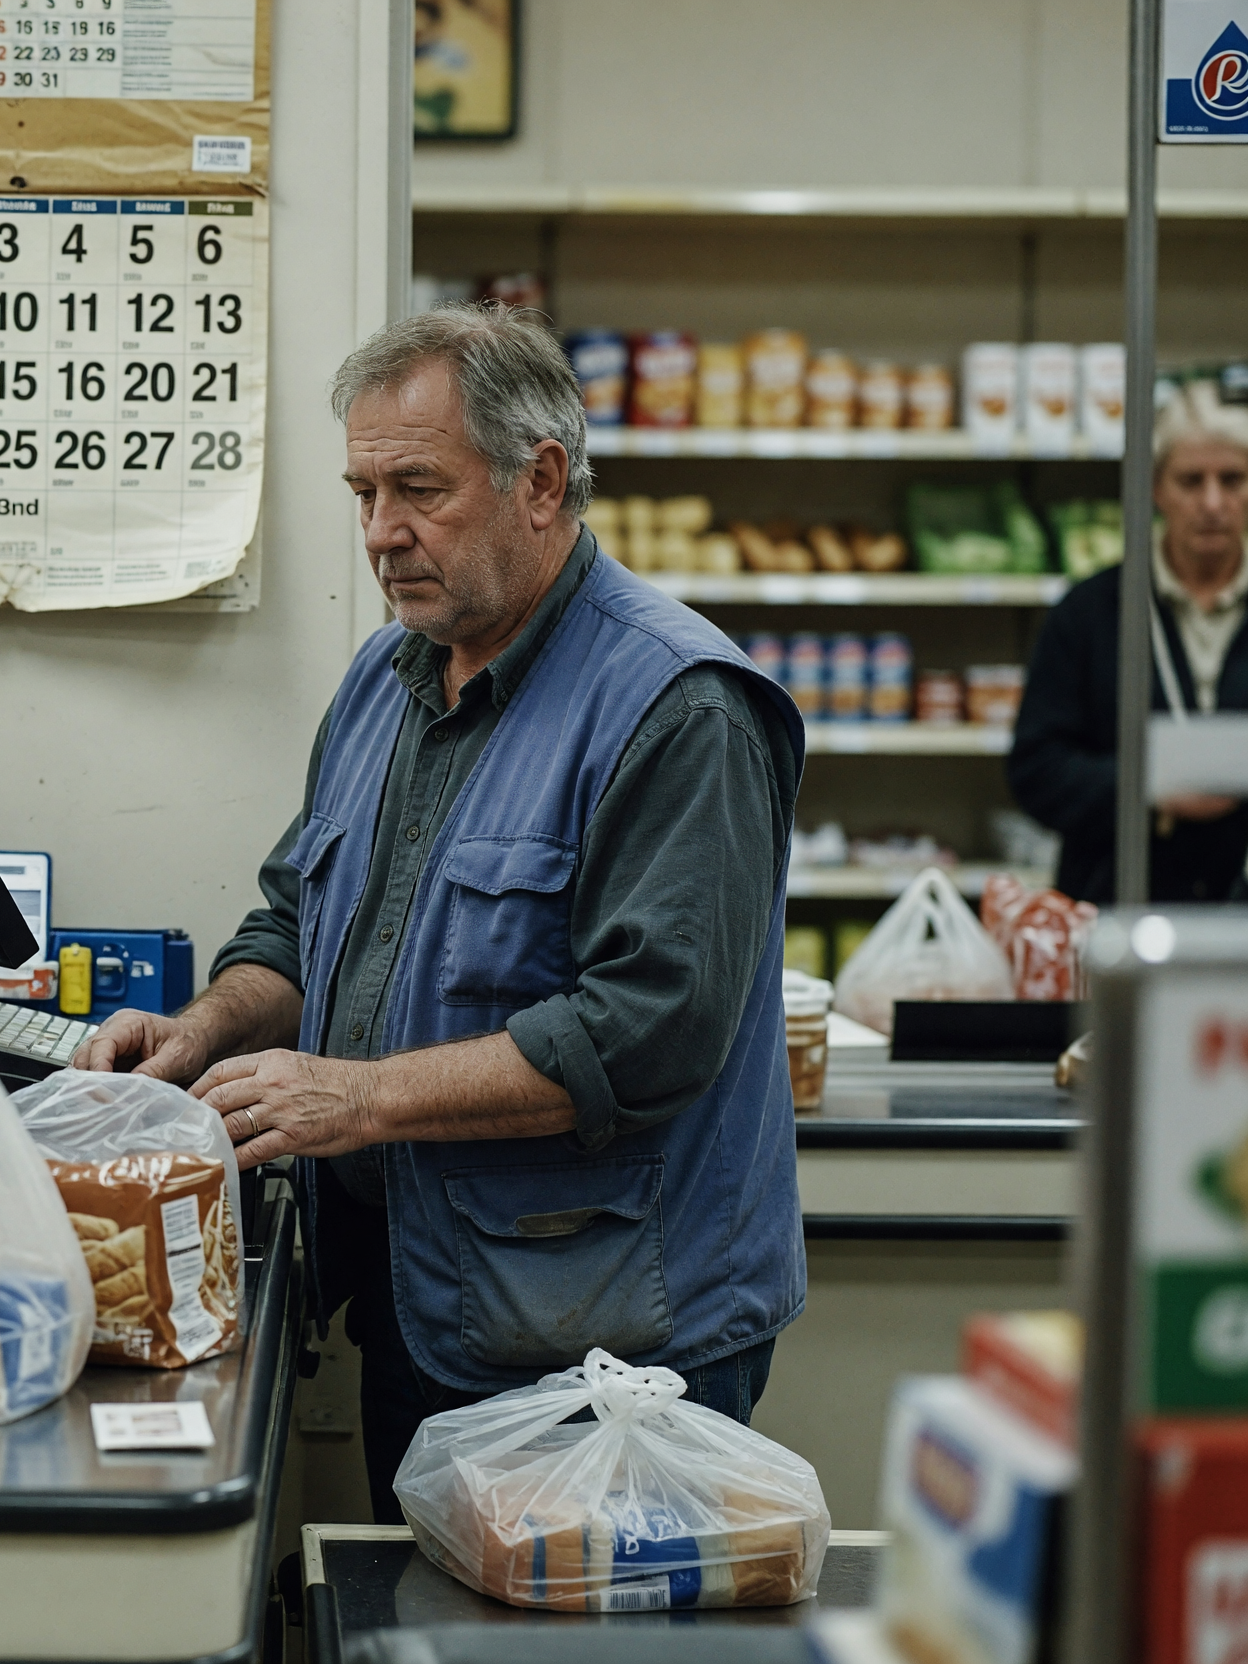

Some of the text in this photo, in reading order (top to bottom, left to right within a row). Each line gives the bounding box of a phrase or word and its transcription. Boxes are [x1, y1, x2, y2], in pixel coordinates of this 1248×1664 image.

[14, 46, 33, 60] 22
[14, 72, 32, 86] 30
[42, 72, 57, 87] 31
[62, 224, 87, 263] 4
[130, 225, 153, 264] 5
[197, 225, 222, 265] 6
[59, 293, 96, 331] 11
[128, 293, 174, 332] 12
[195, 294, 242, 334] 13
[58, 362, 105, 401] 16
[124, 362, 175, 402] 20
[192, 363, 237, 401] 21
[55, 430, 105, 470] 26
[123, 431, 174, 470] 27
[190, 431, 242, 470] 28
